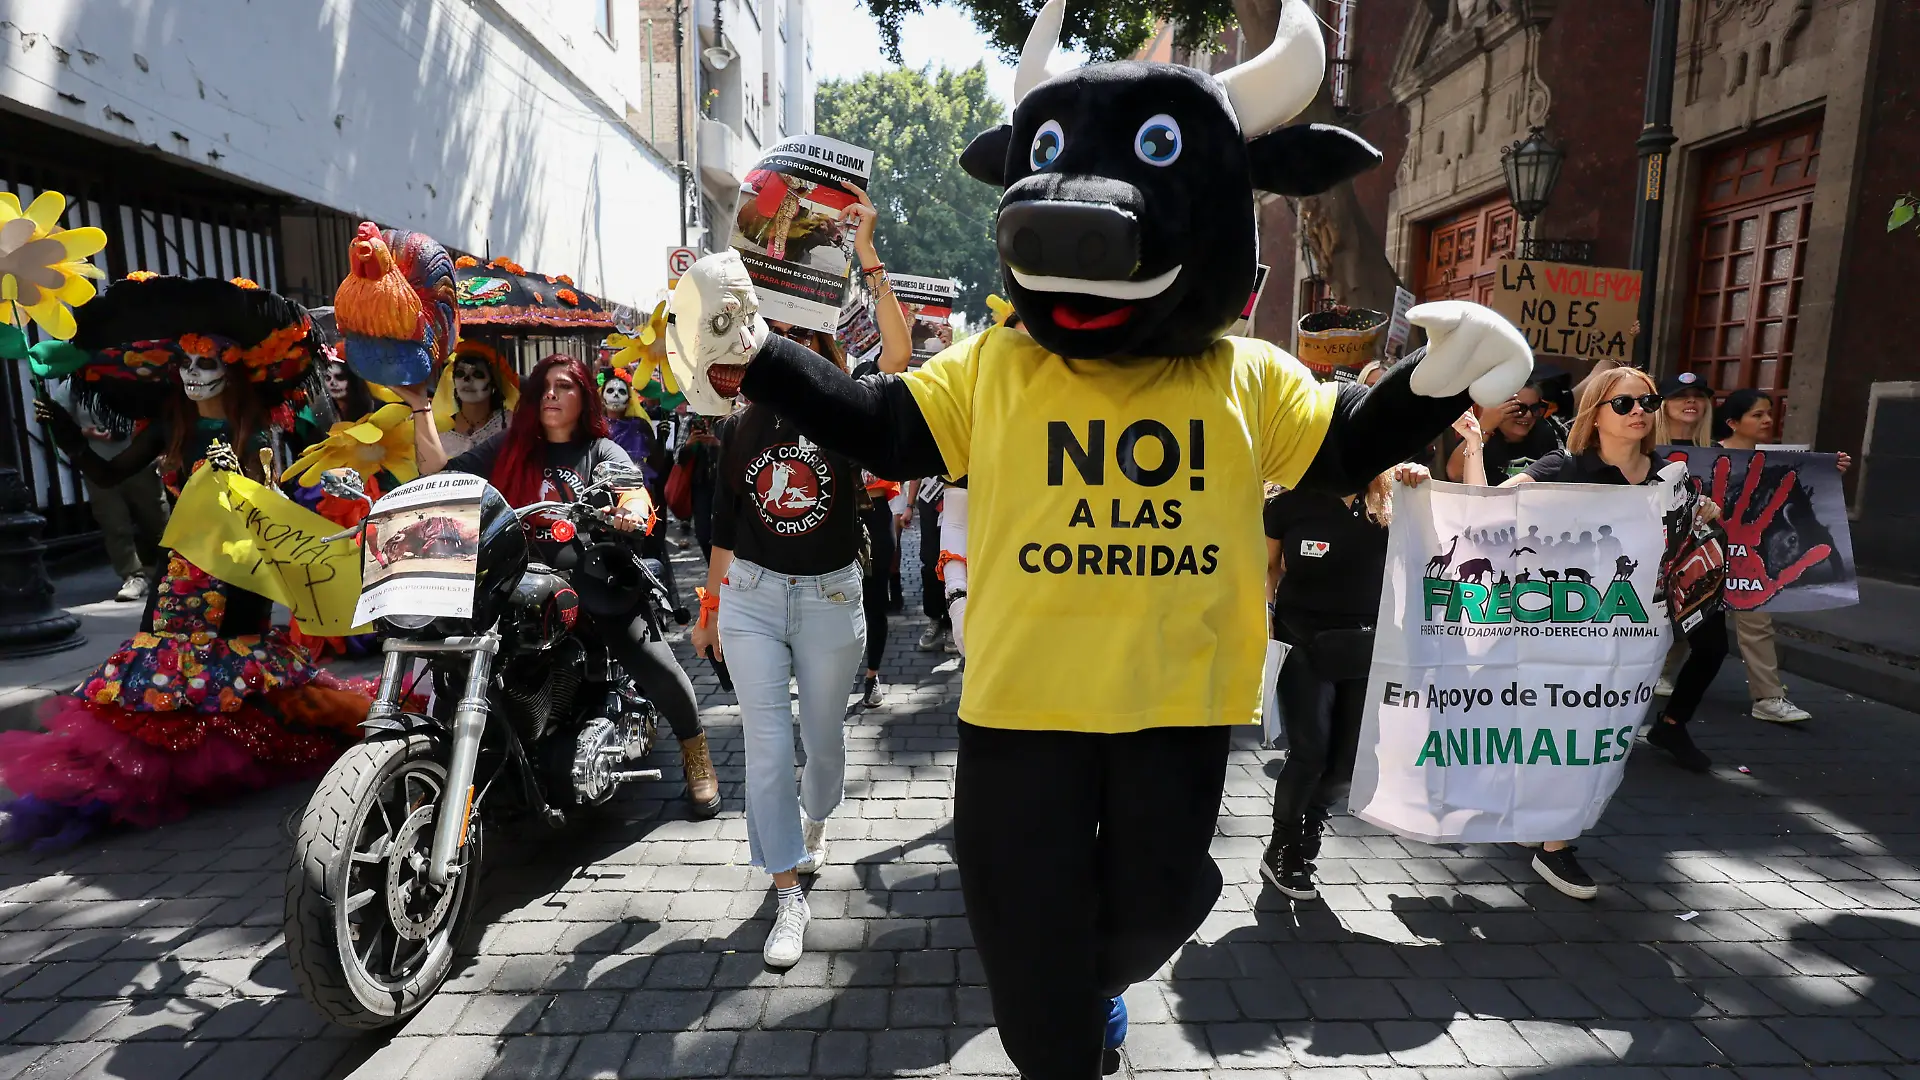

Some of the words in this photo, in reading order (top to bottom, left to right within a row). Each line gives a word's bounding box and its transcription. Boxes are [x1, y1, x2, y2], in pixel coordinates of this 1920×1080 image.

[775, 158, 829, 178] CORRUPCIÓN
[808, 145, 821, 158] DE
[823, 149, 834, 163] LA
[836, 153, 865, 172] CDMX
[742, 256, 763, 267] VOTAR
[764, 261, 793, 276] TAMBIÉN
[802, 273, 843, 289] CORRUPCIÓN
[759, 275, 780, 285] PARA
[780, 280, 815, 294] PROHIBIR
[816, 289, 838, 299] ESTO!
[891, 279, 918, 289] CONGRESO
[918, 281, 926, 290] DE
[926, 282, 933, 291] LA
[934, 283, 950, 293] CDMX
[1502, 262, 1536, 292] LA
[1544, 267, 1641, 302] VIOLENCIA
[1520, 298, 1557, 325] NO
[1568, 301, 1599, 328] ES
[1517, 327, 1626, 357] ULTURA
[745, 450, 775, 485] FUCK
[778, 446, 831, 485] CORRIDA
[1047, 418, 1205, 491] NO!
[382, 484, 424, 501] CONGRESO
[425, 481, 436, 490] DE
[439, 480, 450, 488] LA
[451, 479, 480, 487] CDMX
[749, 492, 773, 523] STOP
[776, 489, 831, 534] CRUELTY
[1068, 498, 1096, 528] A
[1111, 498, 1182, 529] LAS
[1018, 542, 1220, 576] CORRIDAS
[383, 586, 403, 595] PARA
[1725, 579, 1764, 591] URA
[1423, 577, 1649, 624] FRECDA
[1420, 625, 1444, 635] FRENTE
[1446, 625, 1512, 637] CIUDADANO
[1514, 626, 1609, 637] PRO-DERECHO
[1611, 626, 1660, 637] ANIMAL
[1383, 681, 1420, 708] En
[1426, 684, 1493, 714] Apoyo
[1500, 681, 1538, 708] de
[1543, 683, 1632, 709] Todos
[1414, 725, 1633, 768] ANIMALES
